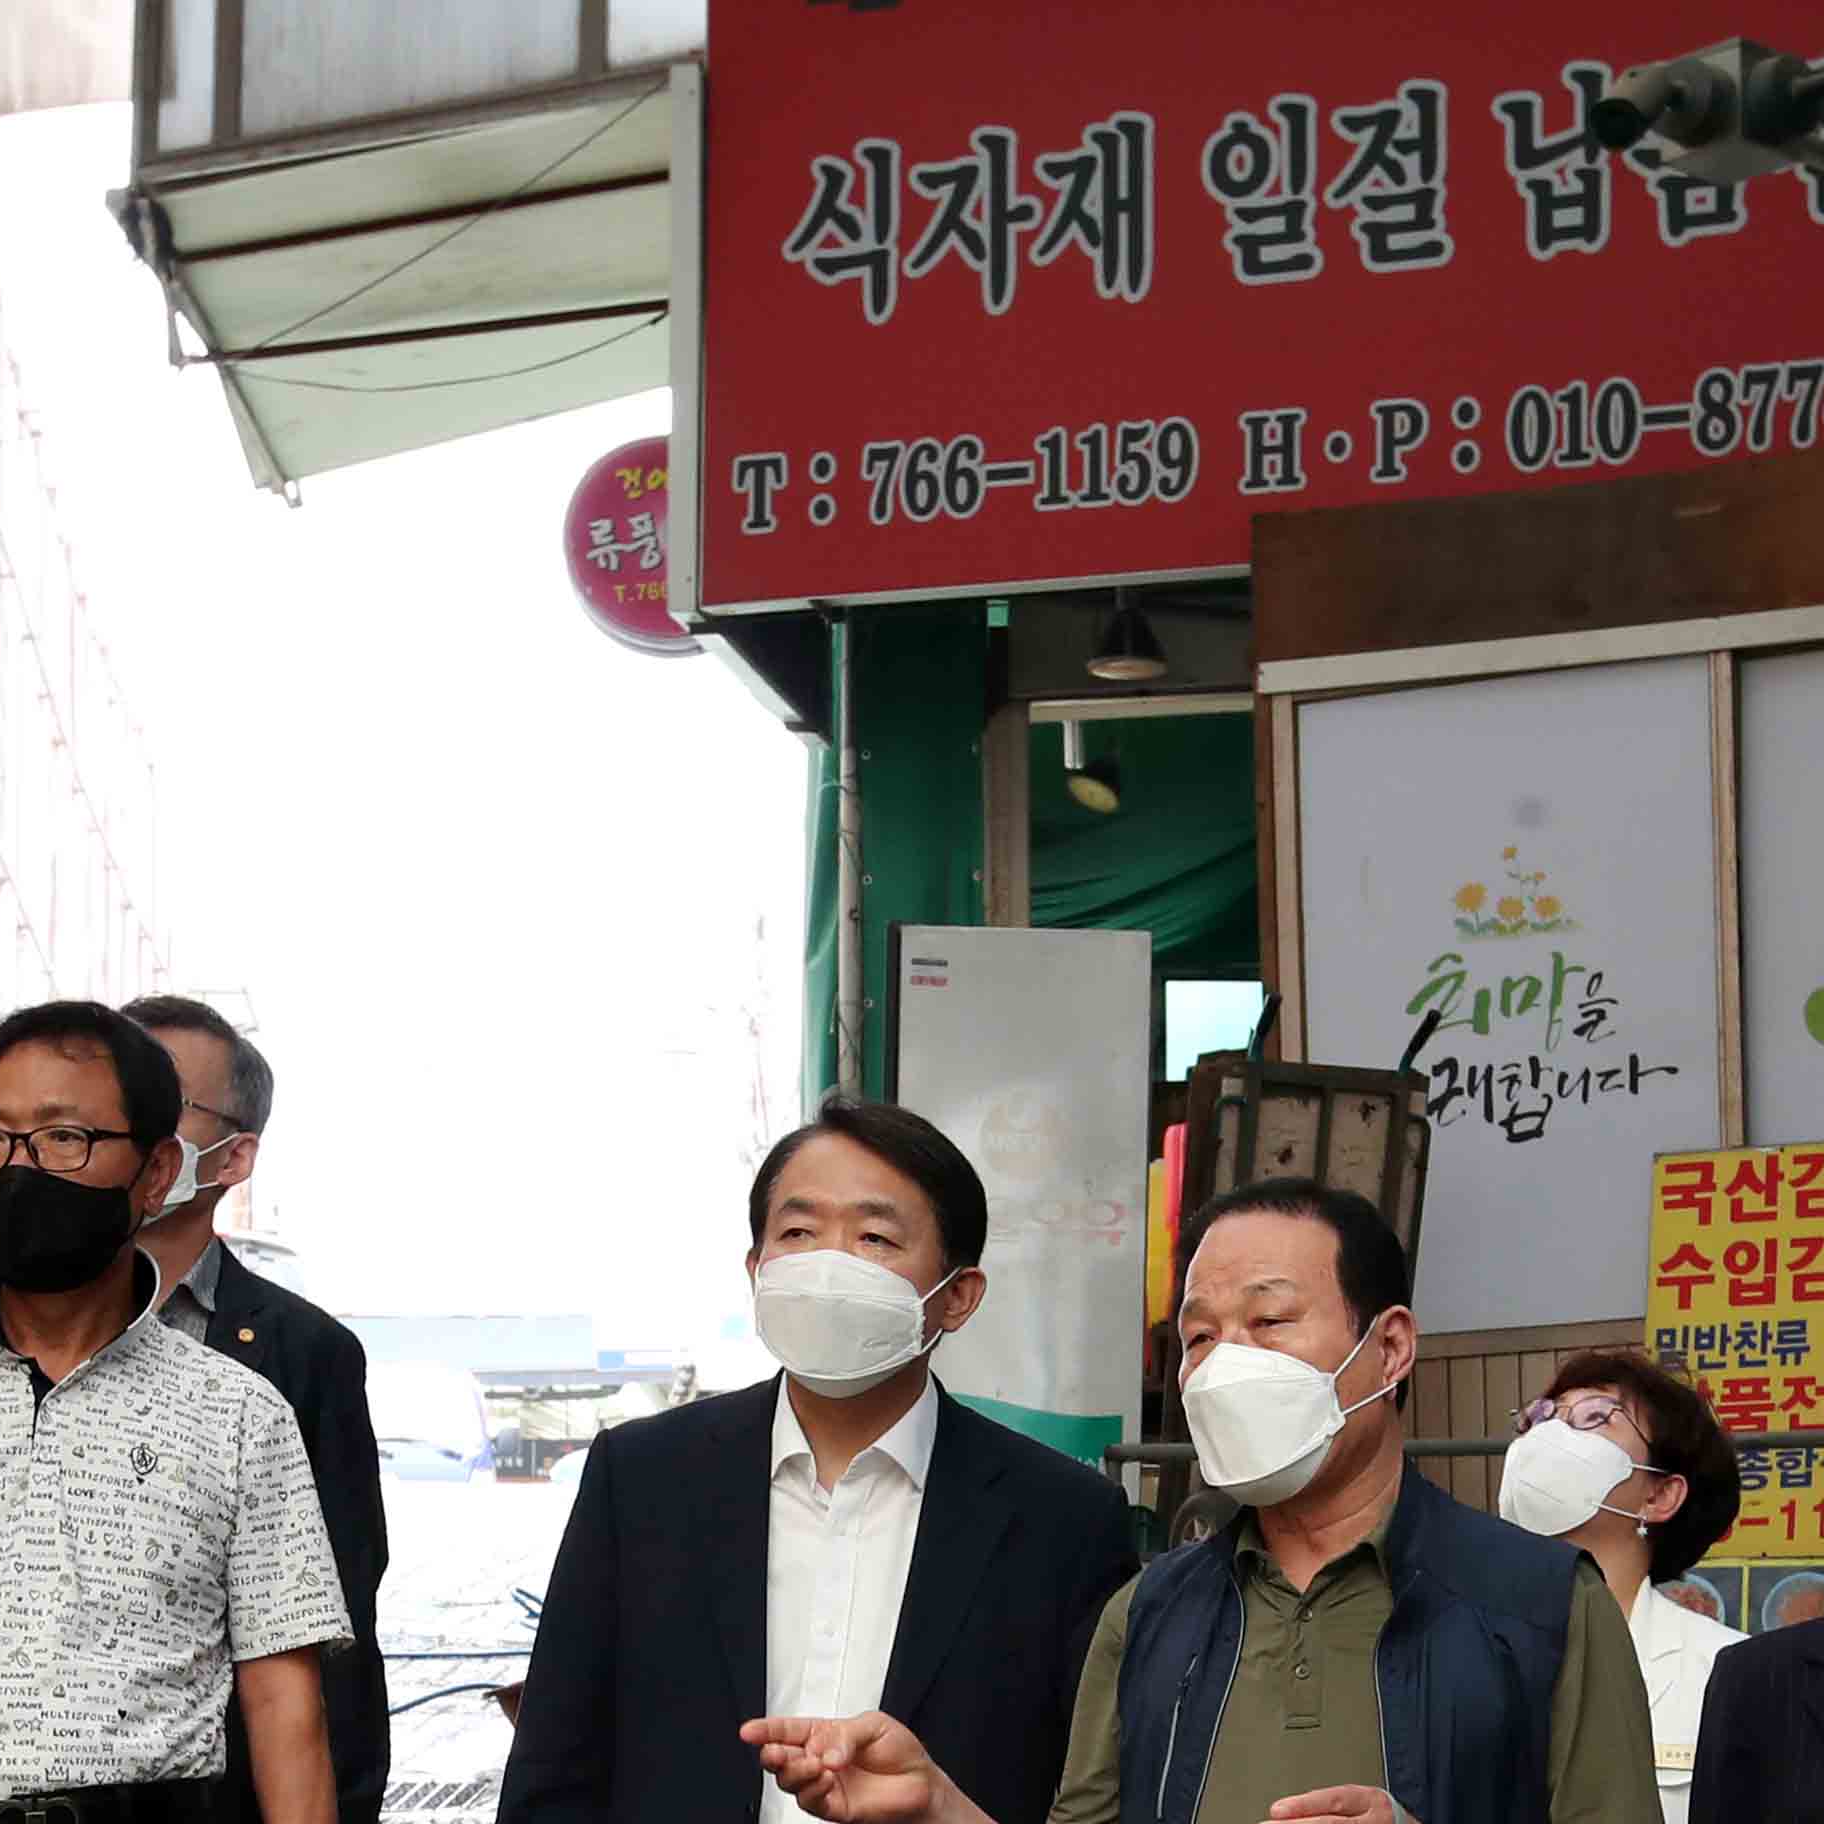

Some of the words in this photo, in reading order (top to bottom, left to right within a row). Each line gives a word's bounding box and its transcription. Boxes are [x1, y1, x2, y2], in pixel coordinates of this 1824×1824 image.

[782, 110, 1156, 326] 식자재
[1202, 78, 1454, 287] 일절
[68, 1488, 95, 1498] LOVE
